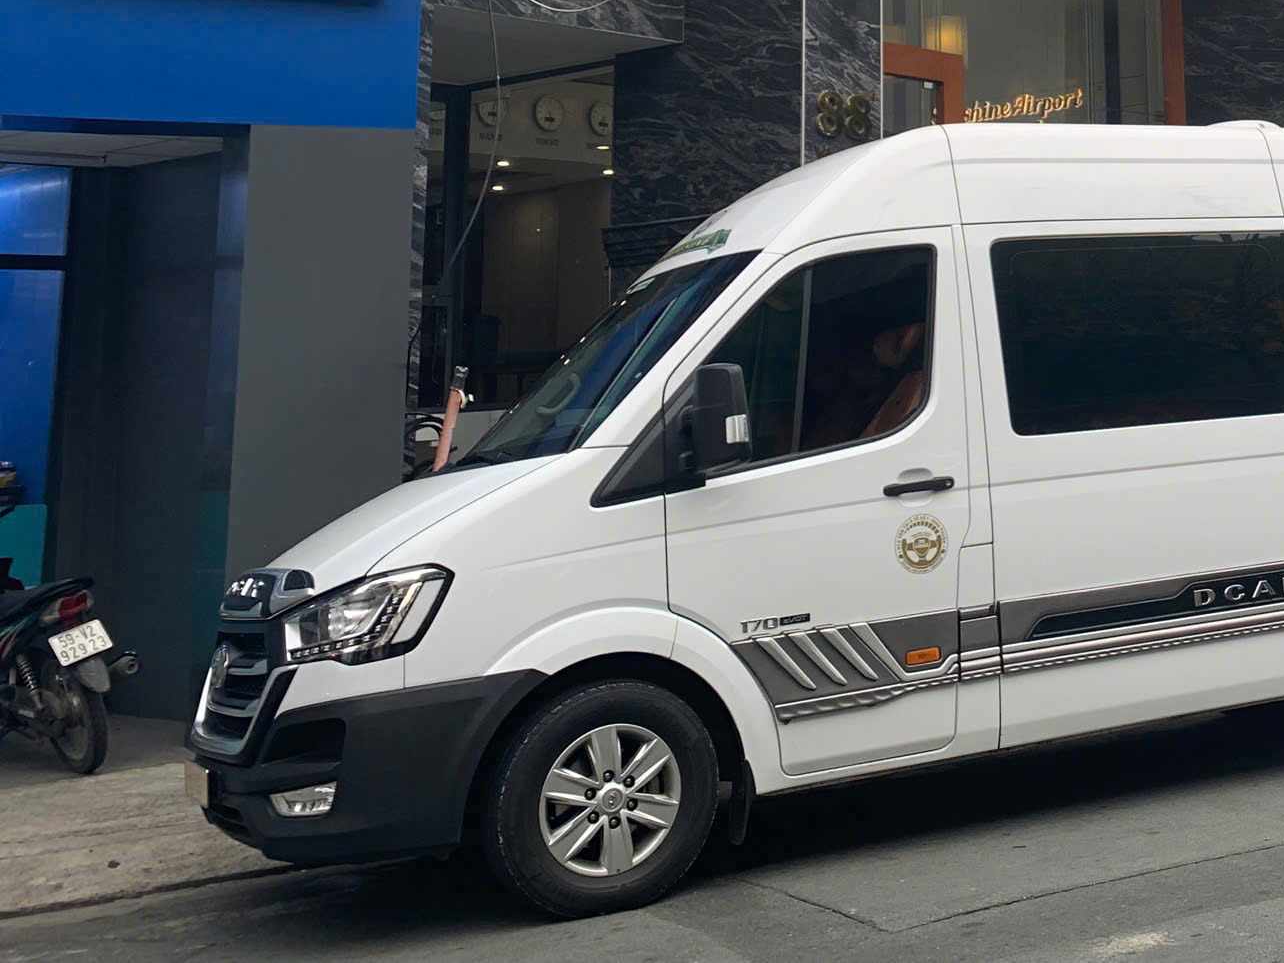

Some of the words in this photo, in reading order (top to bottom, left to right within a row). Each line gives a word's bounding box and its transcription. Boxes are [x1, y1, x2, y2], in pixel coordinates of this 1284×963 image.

[816, 89, 872, 140] 88
[1011, 88, 1083, 119] Airport
[58, 625, 97, 648] 59-V2
[740, 617, 778, 634] 170
